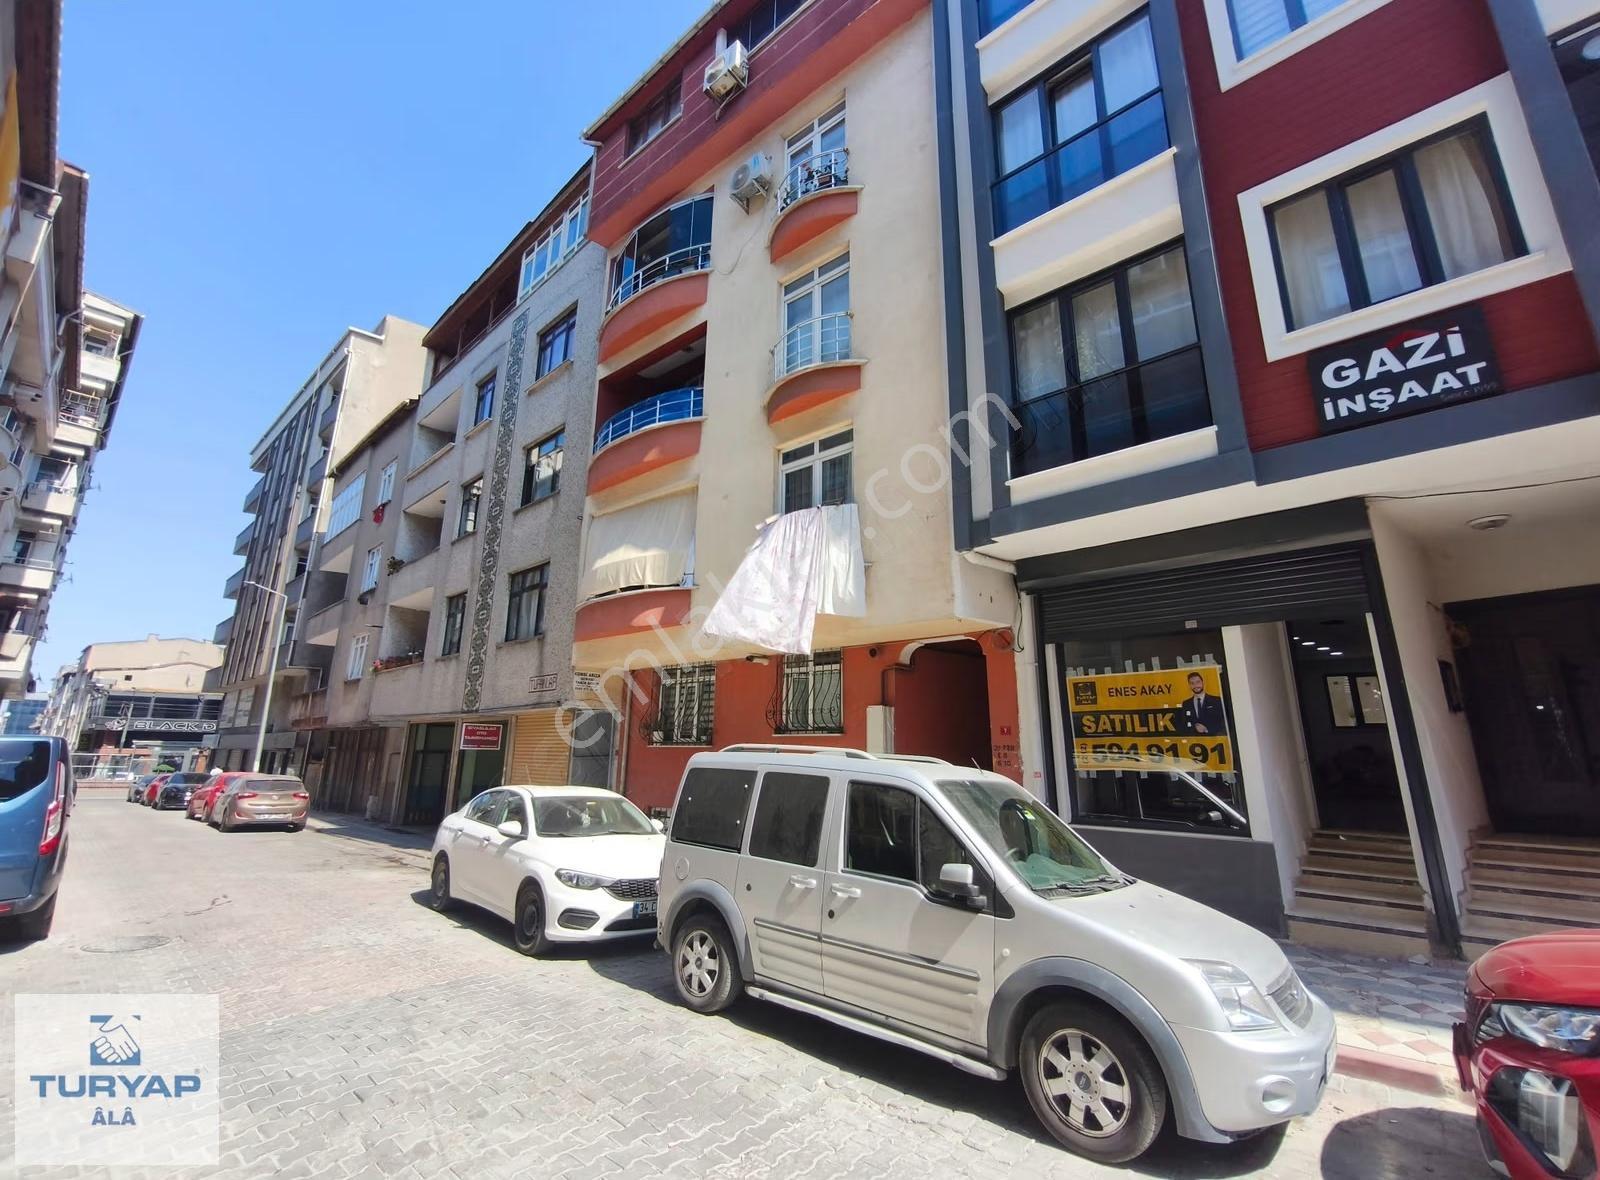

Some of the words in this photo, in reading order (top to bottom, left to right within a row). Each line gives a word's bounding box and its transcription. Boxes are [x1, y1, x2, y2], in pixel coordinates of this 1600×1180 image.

[1322, 326, 1466, 389] GAZİ
[1323, 361, 1487, 421] İNŞAAT
[1108, 687, 1137, 698] ENES
[1140, 684, 1173, 696] AKAY
[133, 720, 199, 732] BLACK
[1081, 713, 1177, 734] SATILIK
[1188, 742, 1227, 765] 91
[640, 902, 649, 913] 34
